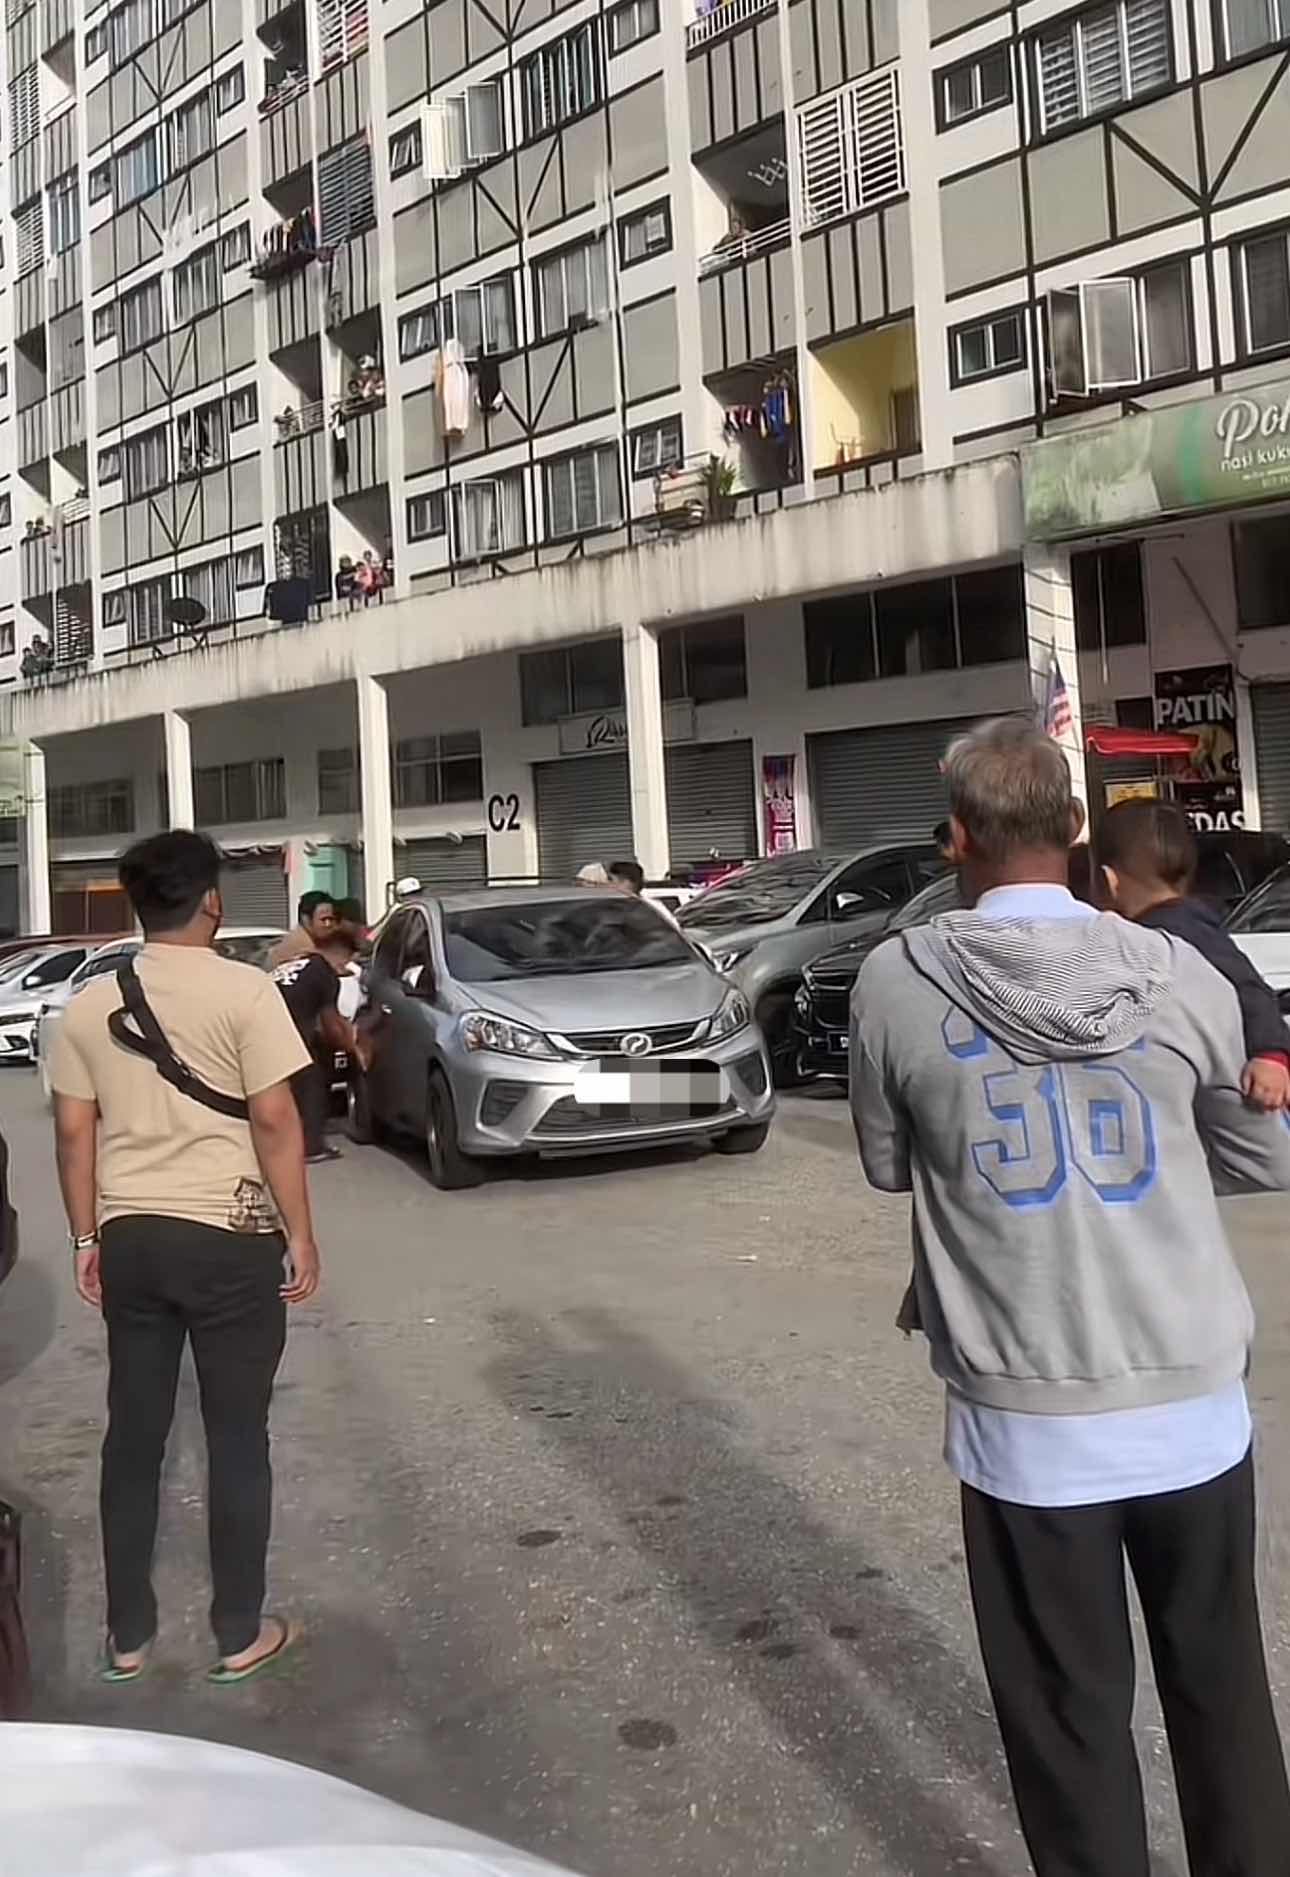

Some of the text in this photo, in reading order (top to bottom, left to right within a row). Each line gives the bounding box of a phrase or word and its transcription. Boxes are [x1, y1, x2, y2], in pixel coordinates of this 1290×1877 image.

[1221, 445, 1290, 472] nasi kuk
[1158, 691, 1234, 724] PATIN
[488, 794, 520, 832] C2
